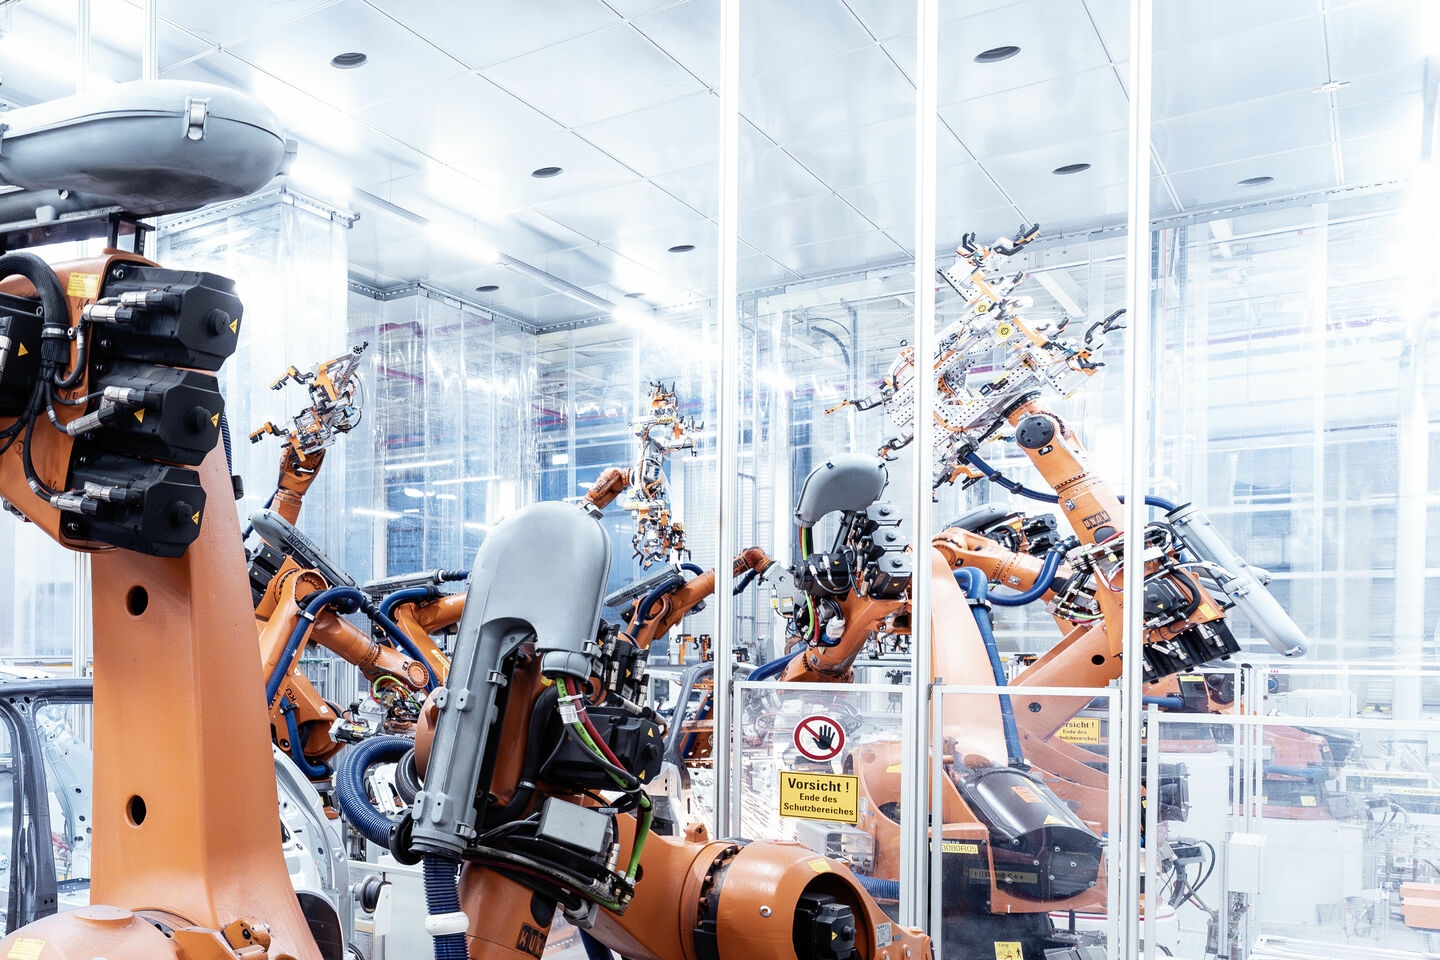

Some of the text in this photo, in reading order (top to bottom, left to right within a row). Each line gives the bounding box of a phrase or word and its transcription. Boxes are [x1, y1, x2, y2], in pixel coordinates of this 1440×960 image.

[788, 778, 850, 793] Vorsicht !
[799, 793, 838, 803] Ende des
[783, 802, 854, 816] Schutzbereiches
[942, 844, 977, 853] 3080R05
[518, 929, 546, 956] KUK
